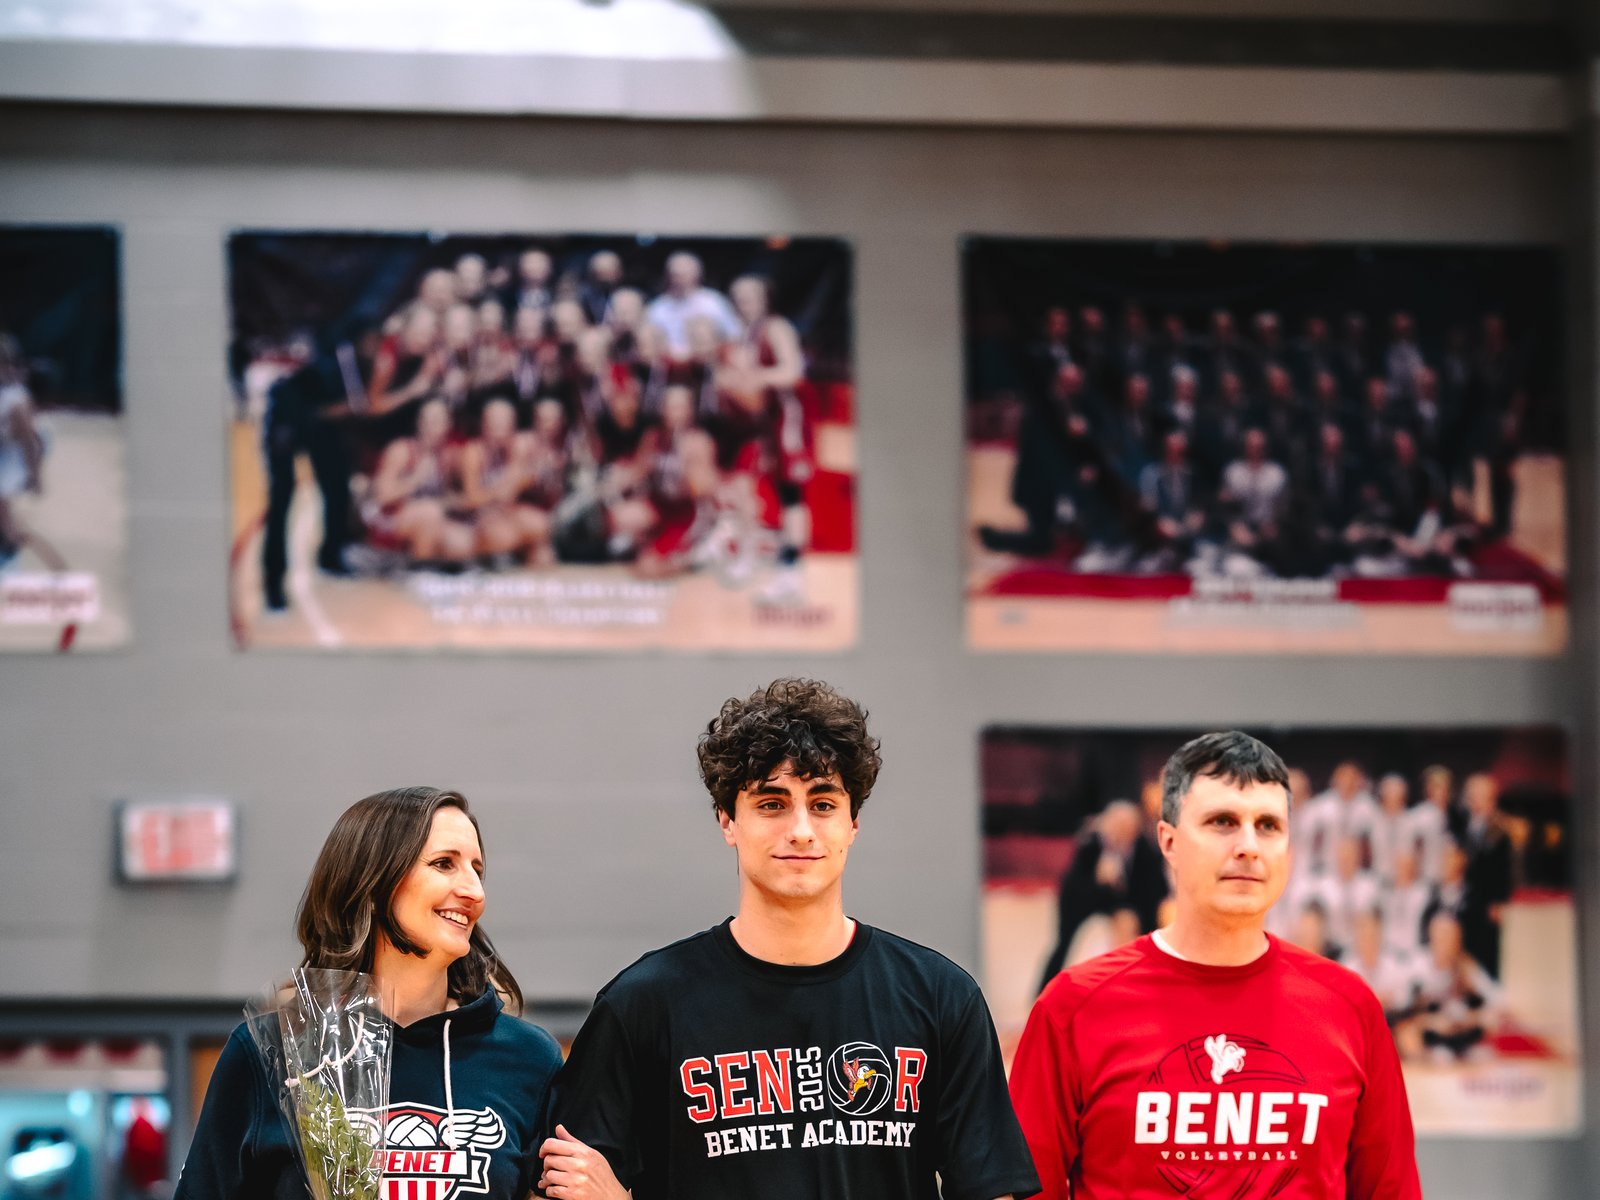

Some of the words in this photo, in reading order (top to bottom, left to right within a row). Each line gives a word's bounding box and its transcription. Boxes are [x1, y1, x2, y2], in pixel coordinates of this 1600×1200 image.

[796, 1046, 825, 1113] 2025
[704, 1123, 794, 1158] BENET
[801, 1119, 916, 1148] ACADEMY
[1134, 1091, 1329, 1145] BENET
[1160, 1150, 1299, 1161] VOLLEYBALL
